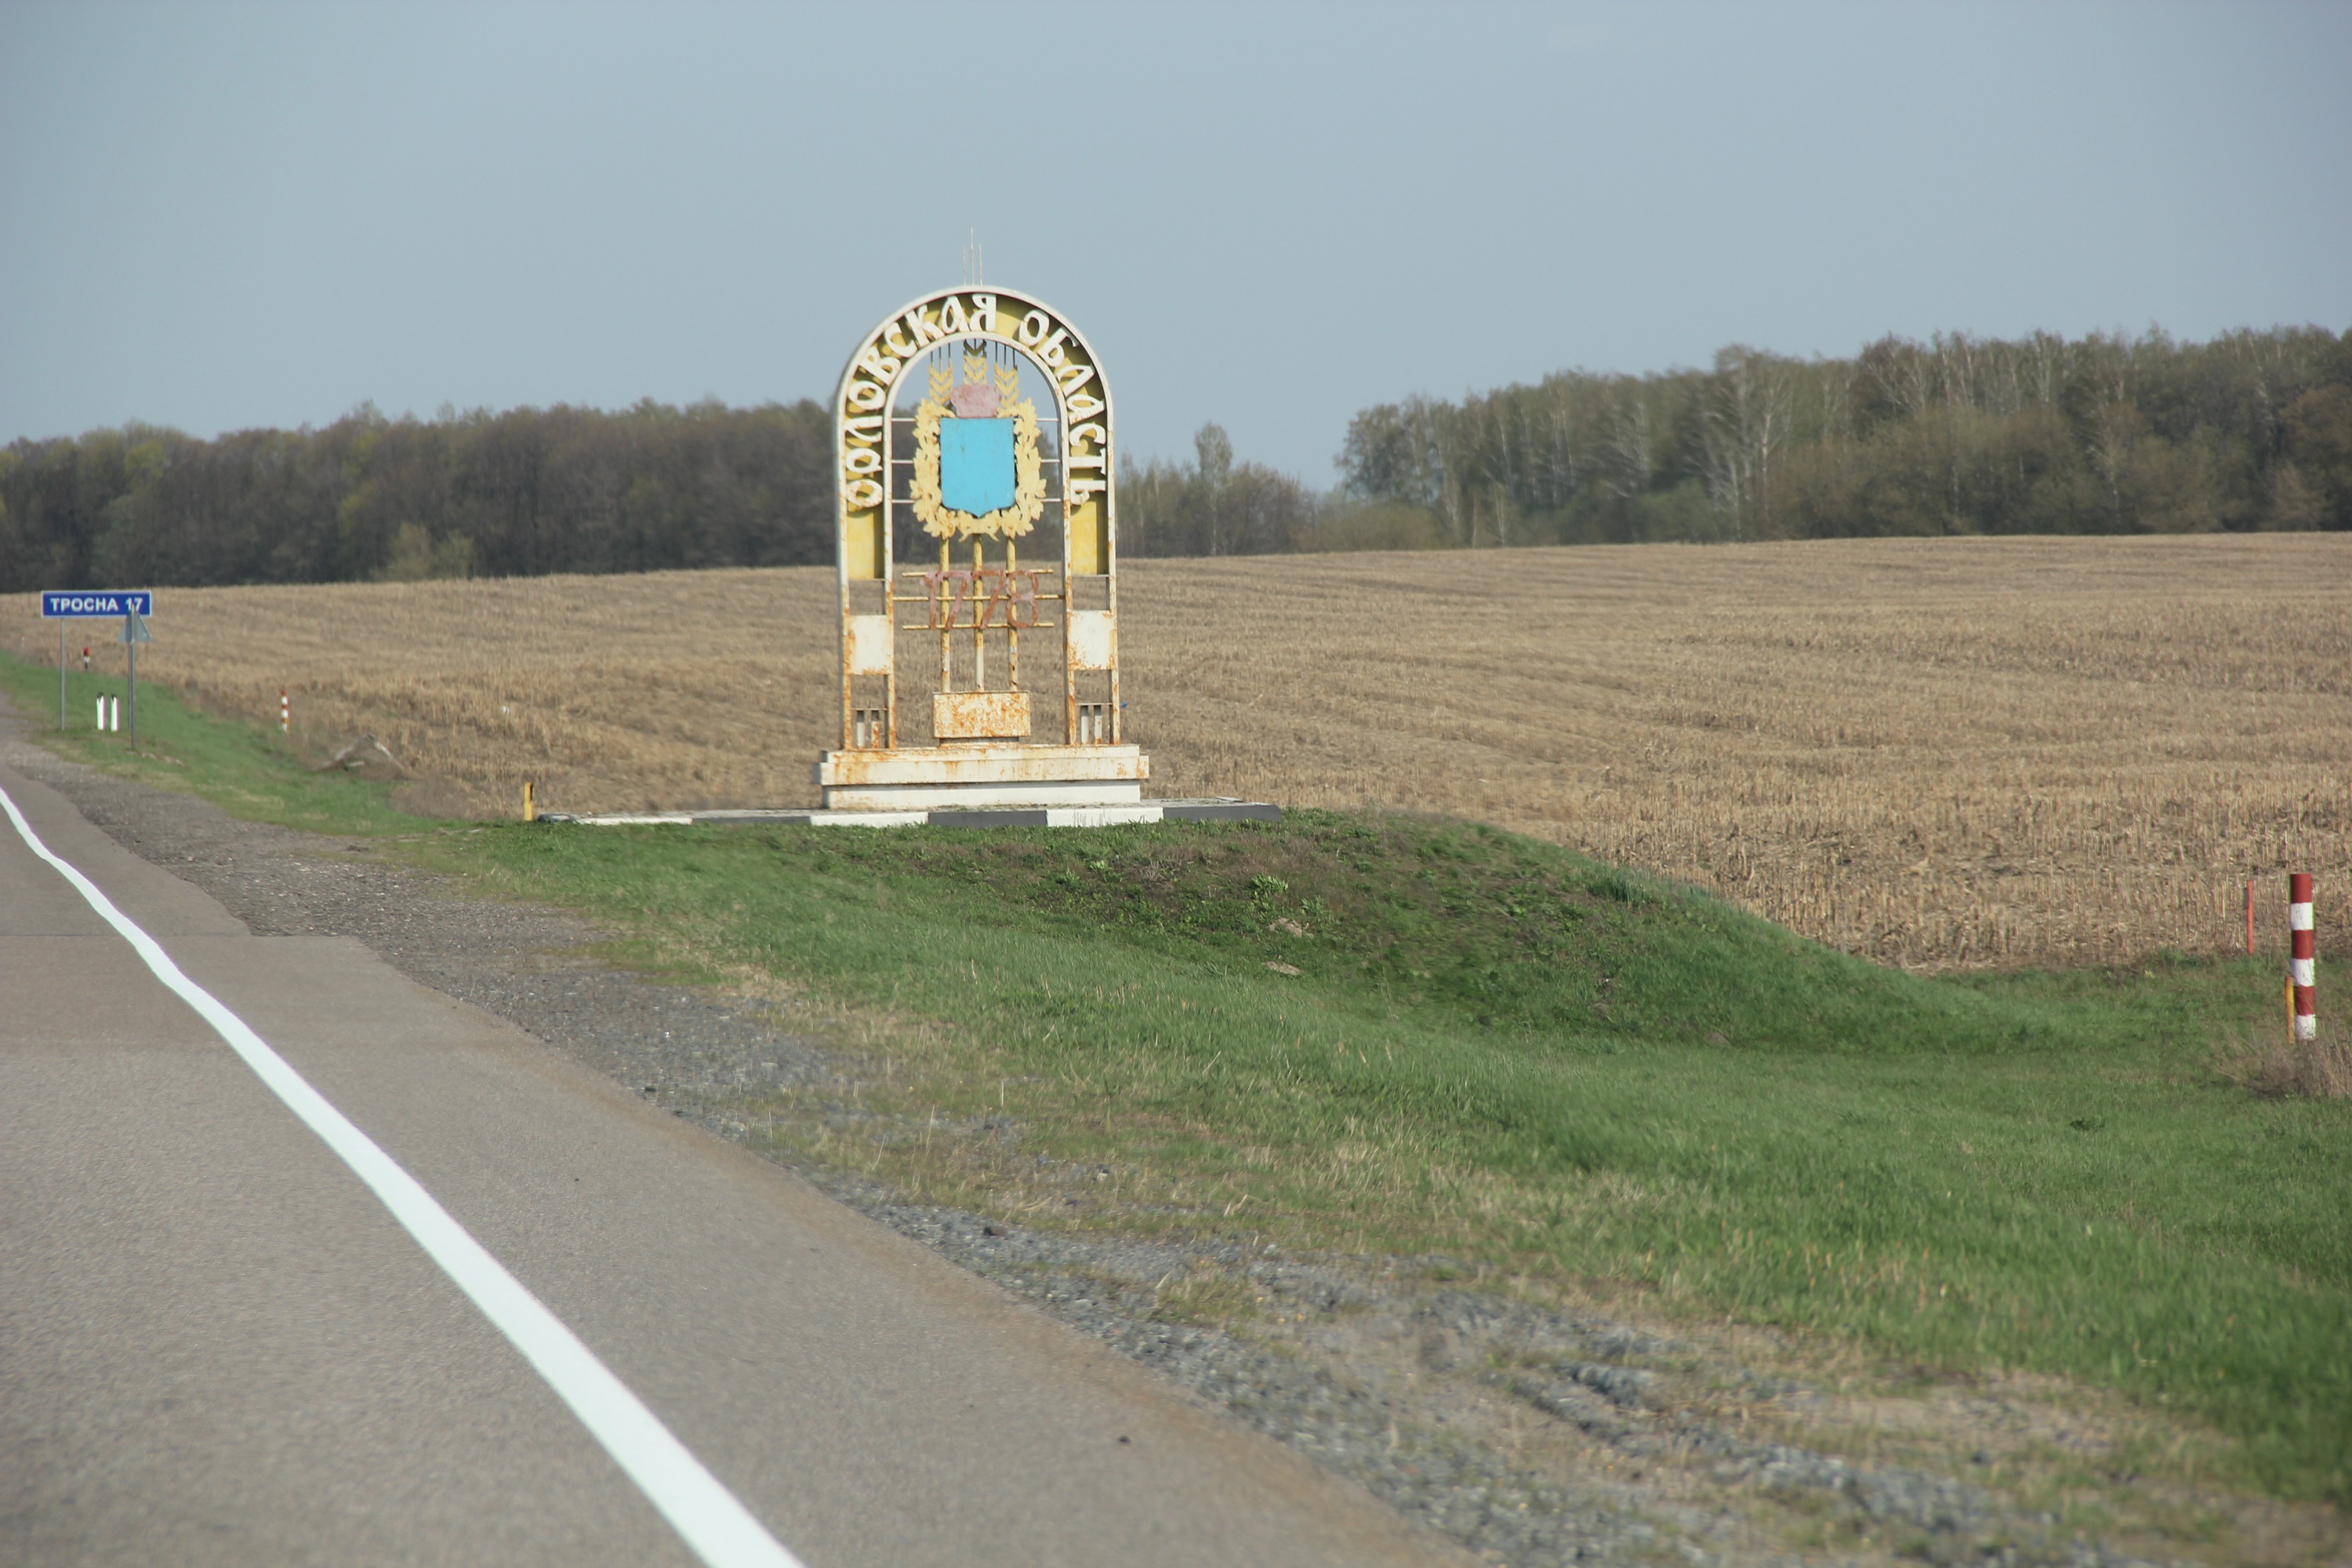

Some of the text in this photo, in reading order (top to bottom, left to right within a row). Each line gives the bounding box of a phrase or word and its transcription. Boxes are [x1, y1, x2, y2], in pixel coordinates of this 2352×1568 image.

[844, 293, 1107, 508] ОРЛОВСКАЯ ОБЛАСТЬ
[50, 597, 143, 612] ТРОСНА 17
[920, 570, 1040, 630] 1778
